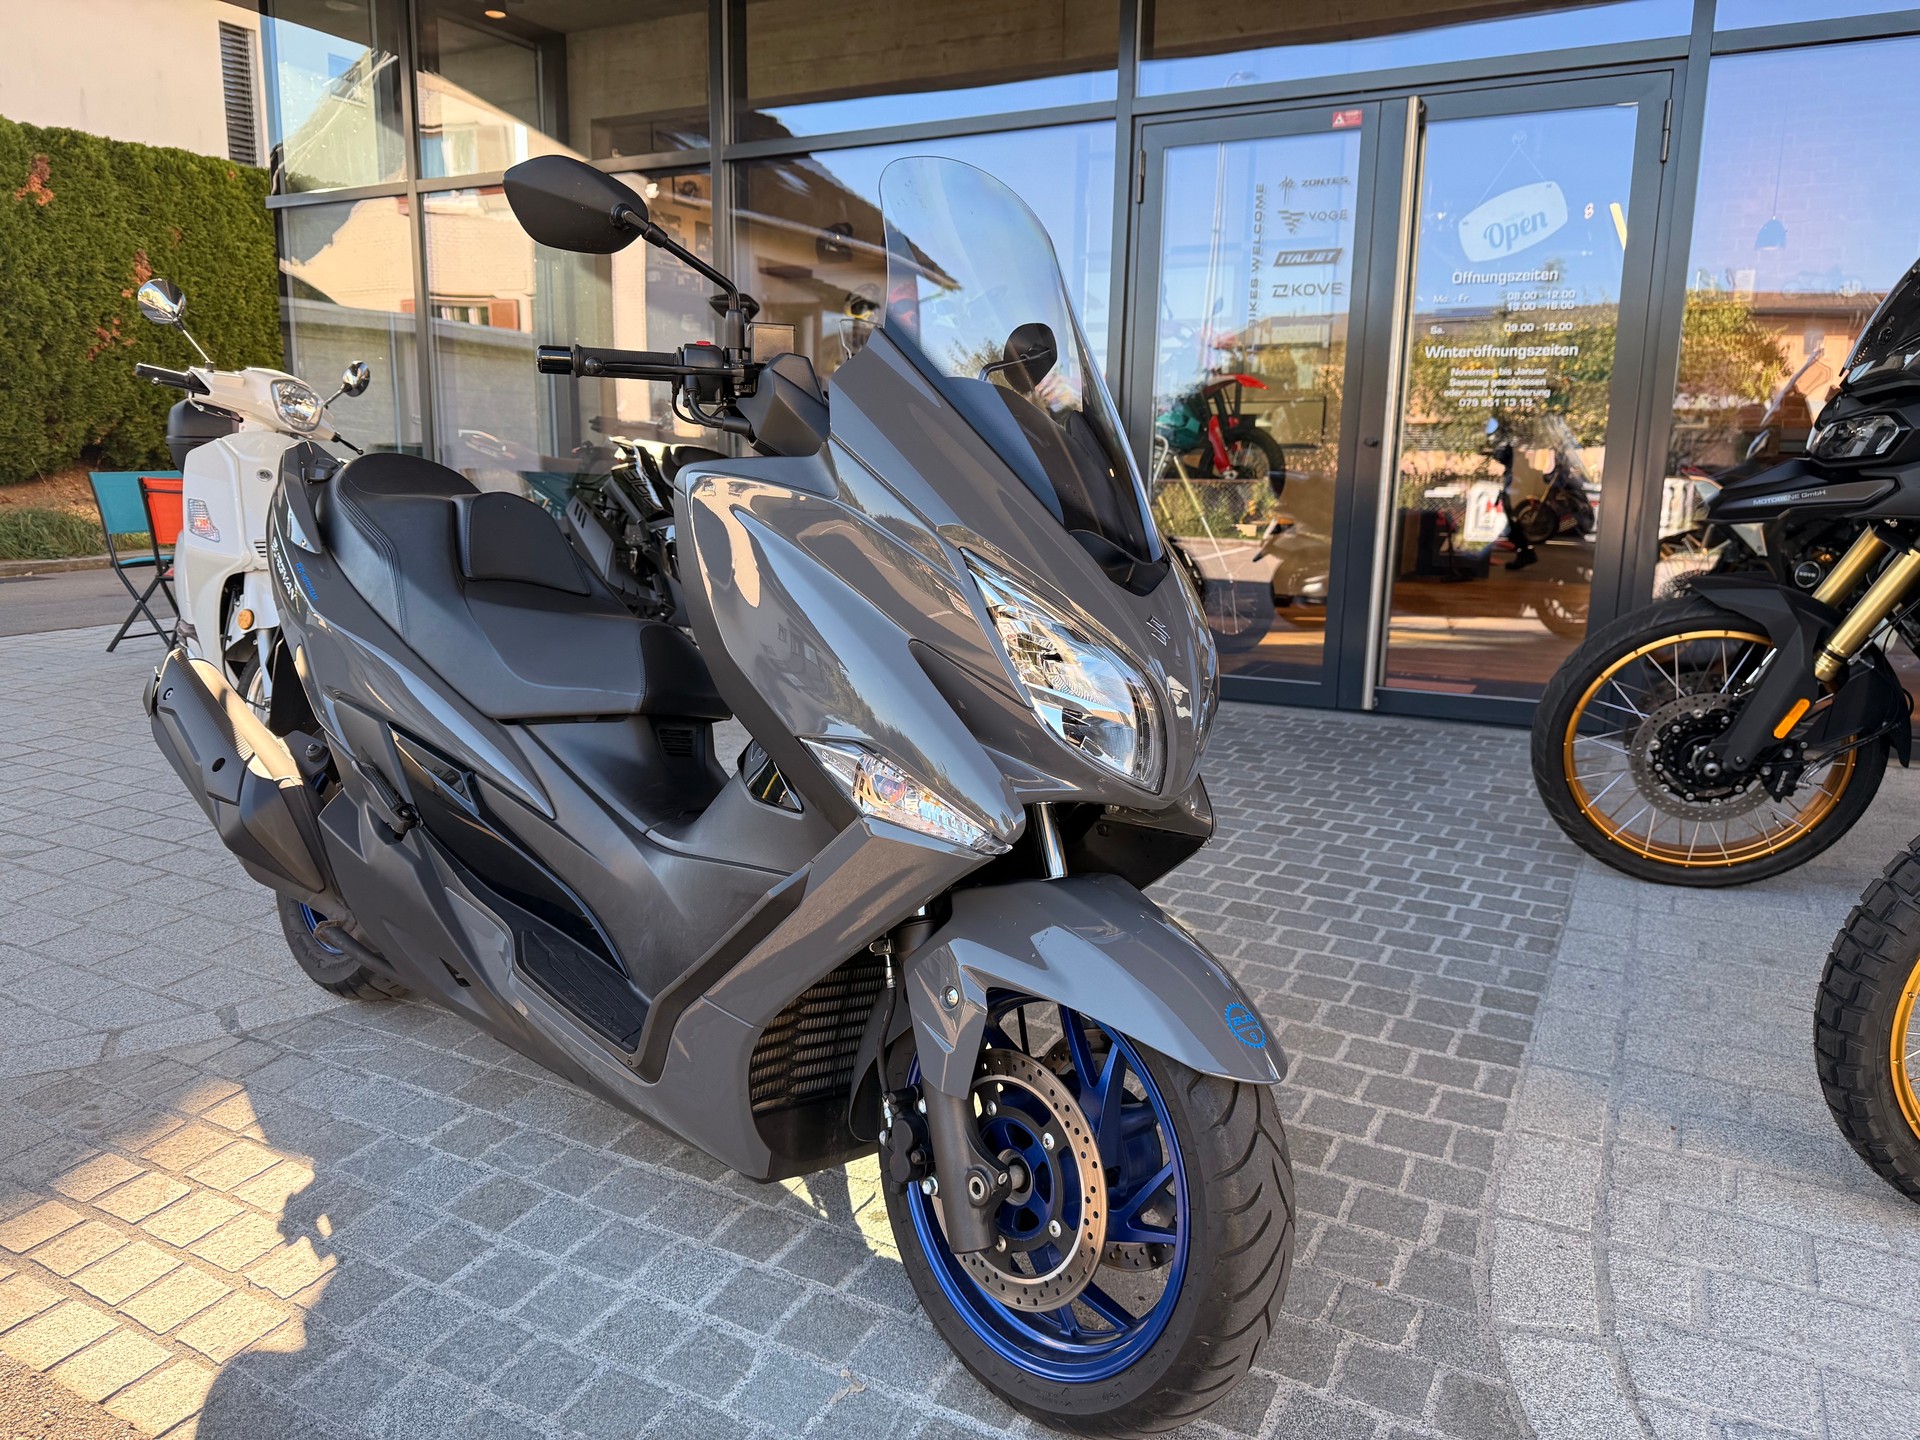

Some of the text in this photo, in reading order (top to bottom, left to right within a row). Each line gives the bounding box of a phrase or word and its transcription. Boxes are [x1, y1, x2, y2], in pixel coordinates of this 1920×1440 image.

[1308, 209, 1348, 222] VOGE
[1483, 211, 1548, 251] Open
[1248, 183, 1265, 329] BIKES WELCOME
[1452, 269, 1559, 286] Öffnungszeiten
[1291, 282, 1343, 297] KOVE
[1543, 321, 1574, 332] 12.00
[1425, 343, 1579, 360] Winteröffnungszeiten
[1801, 489, 1826, 499] GmbH
